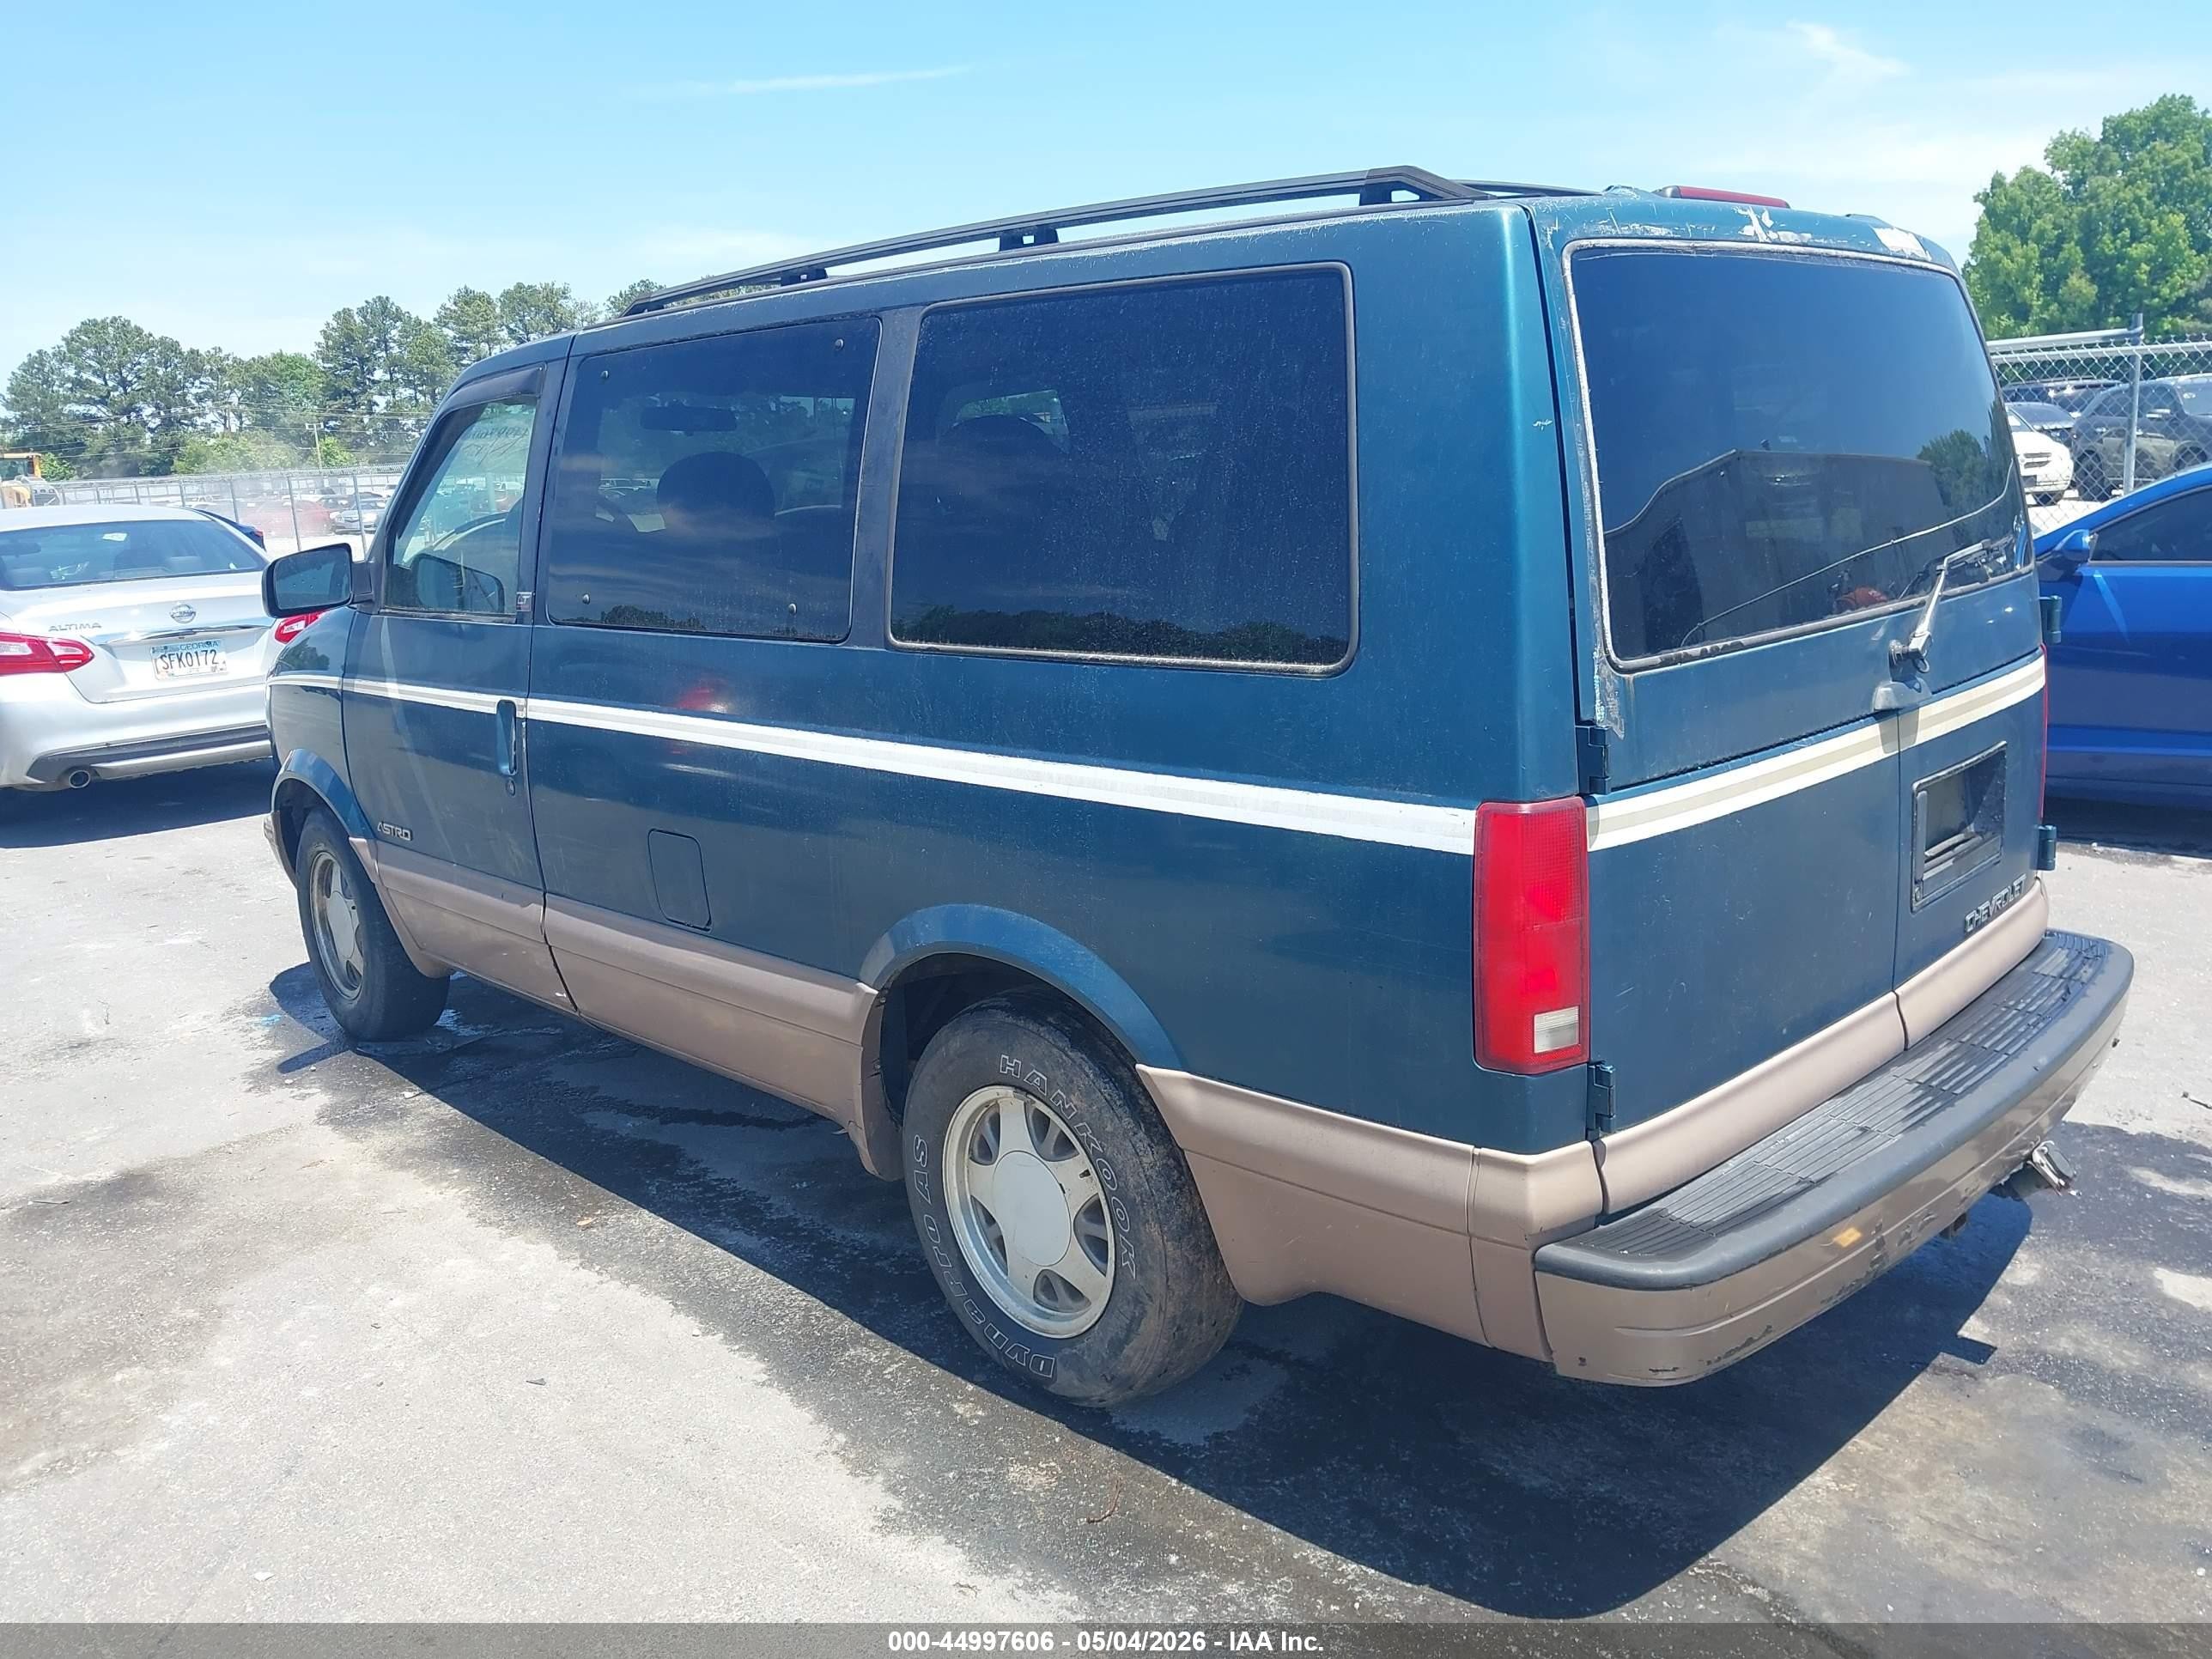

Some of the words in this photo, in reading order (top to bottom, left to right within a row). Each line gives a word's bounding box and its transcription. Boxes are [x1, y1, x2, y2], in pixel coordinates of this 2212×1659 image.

[517, 595, 531, 605] LT
[48, 622, 102, 632] ALTIMA
[179, 641, 219, 651] GEORGIA
[159, 649, 220, 670] SFK0172
[377, 822, 412, 841] ASTRO
[1965, 873, 2027, 933] CHEVROLET
[914, 1134, 932, 1205] AS
[1000, 1054, 1136, 1279] HANKOOK
